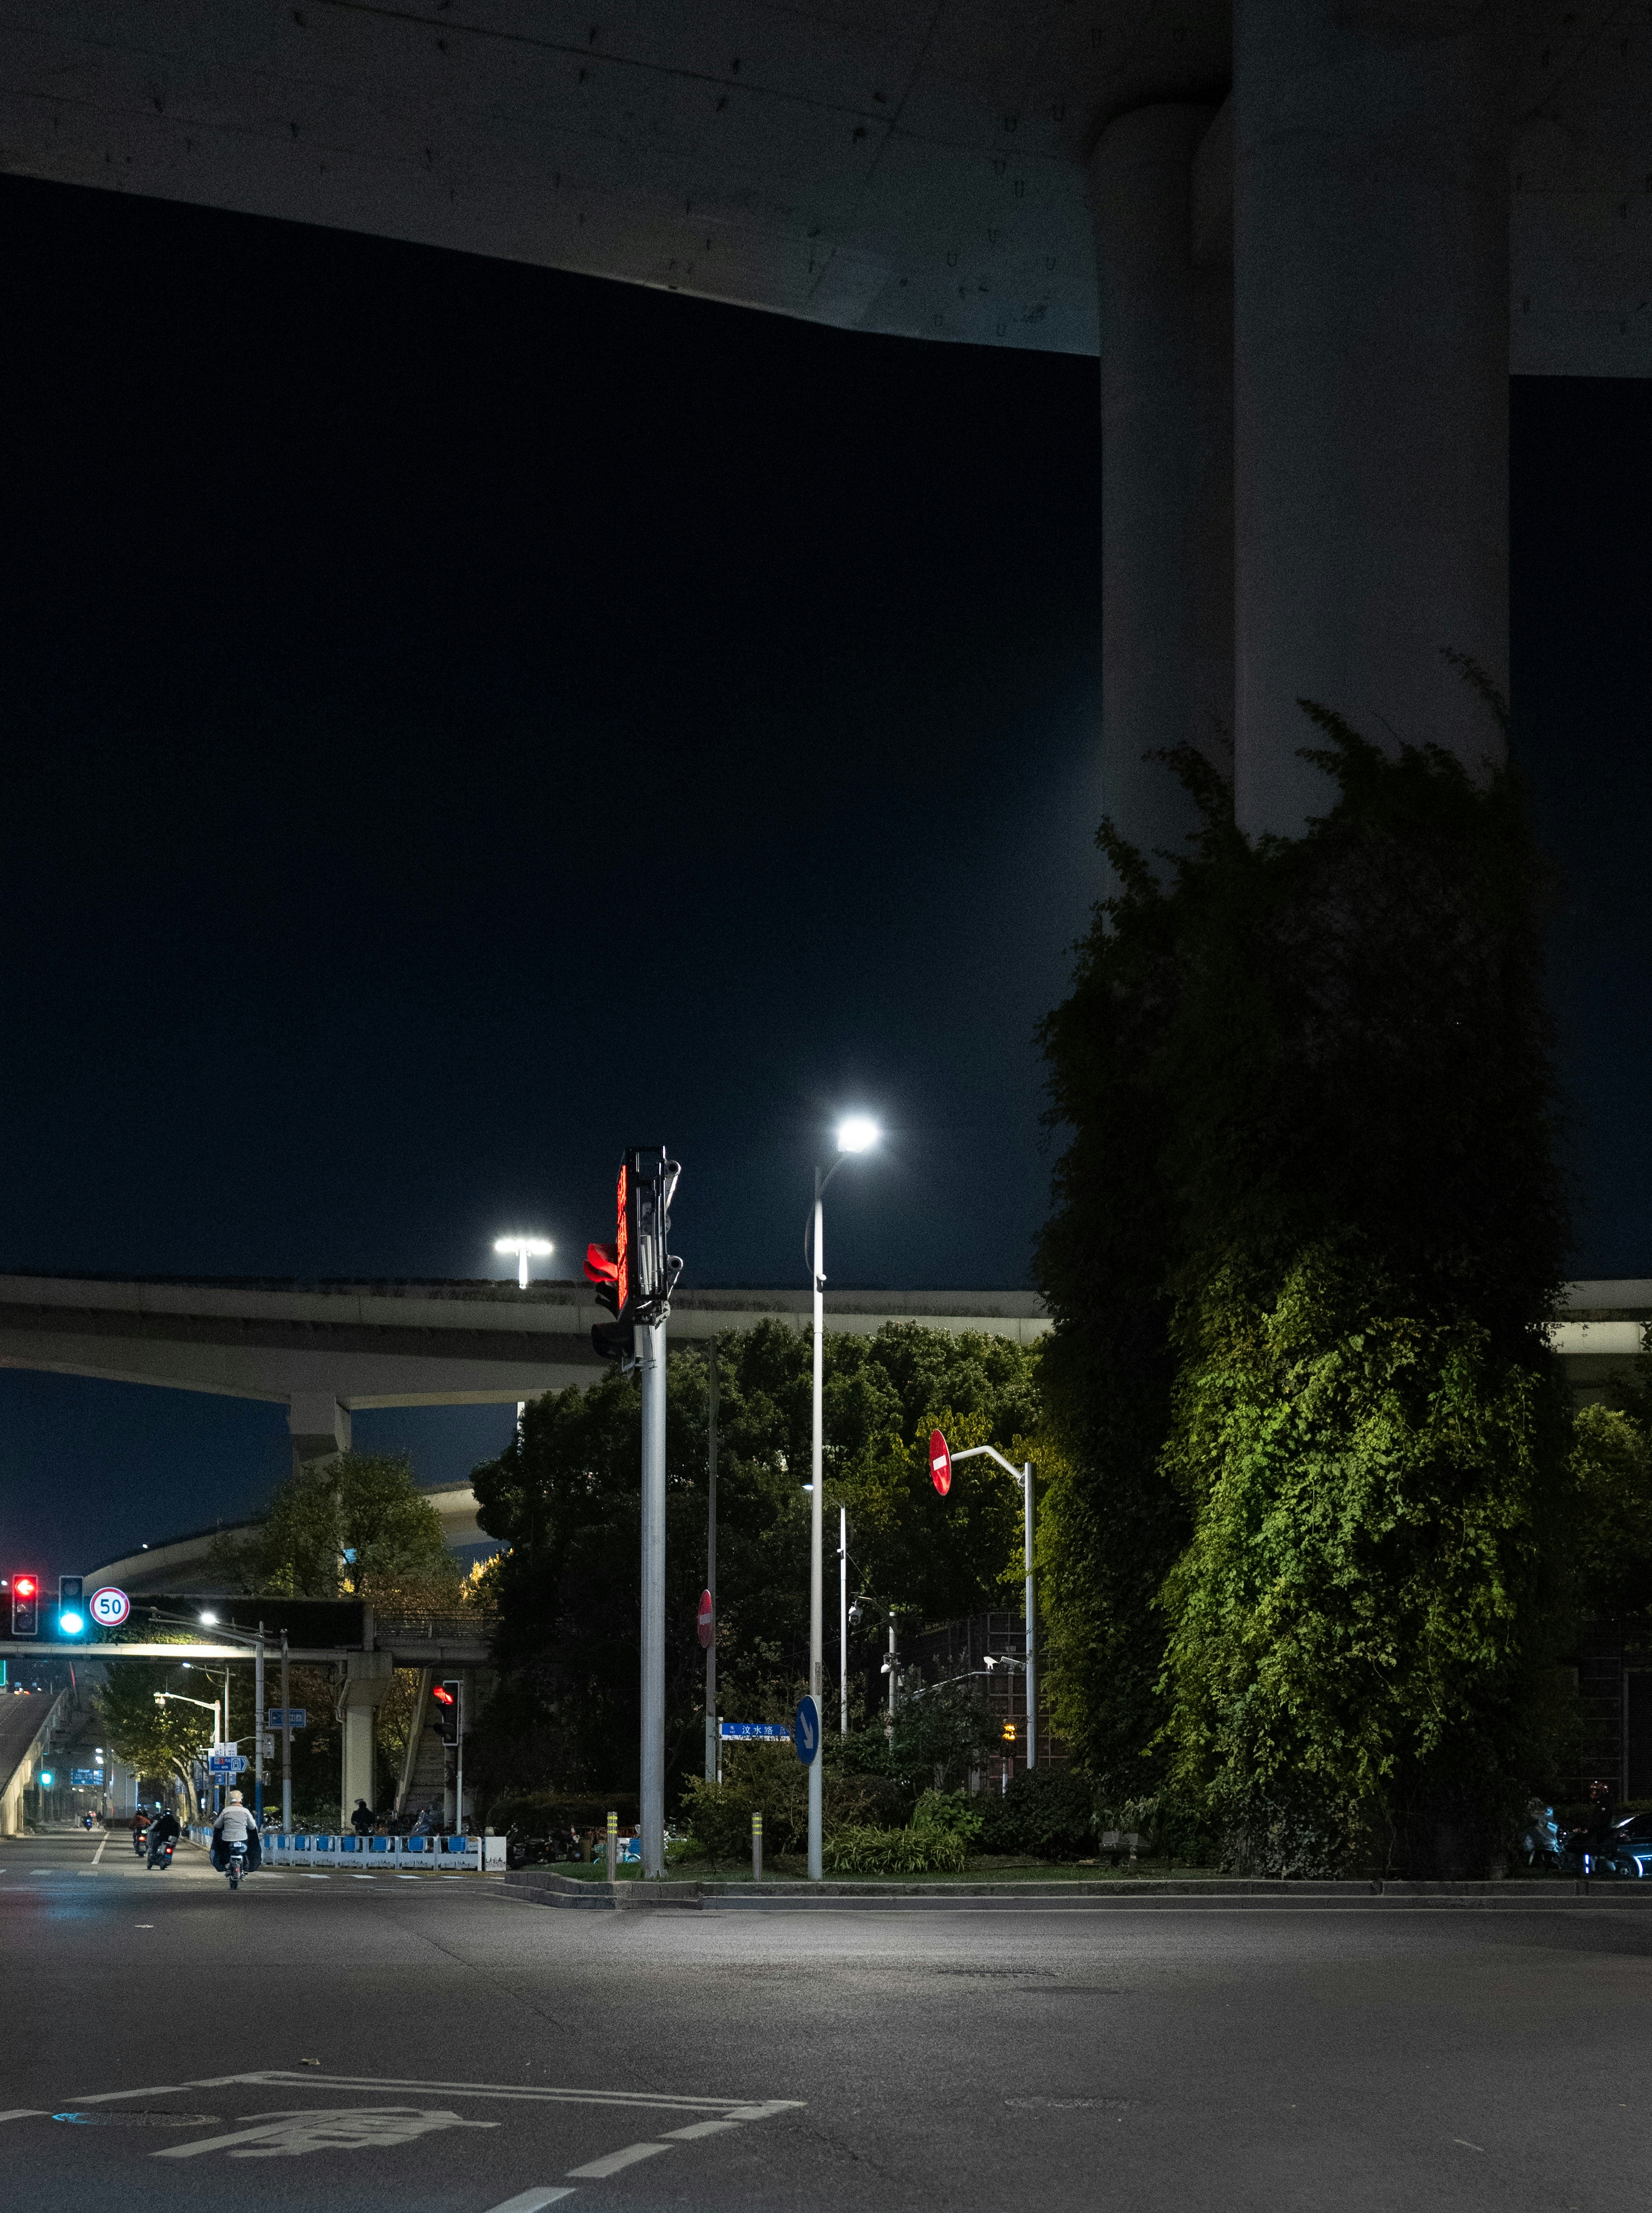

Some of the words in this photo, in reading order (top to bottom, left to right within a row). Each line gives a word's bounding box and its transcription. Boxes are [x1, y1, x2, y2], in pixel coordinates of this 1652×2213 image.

[100, 1599, 121, 1614] 50
[741, 1725, 773, 1735] 汶水路
